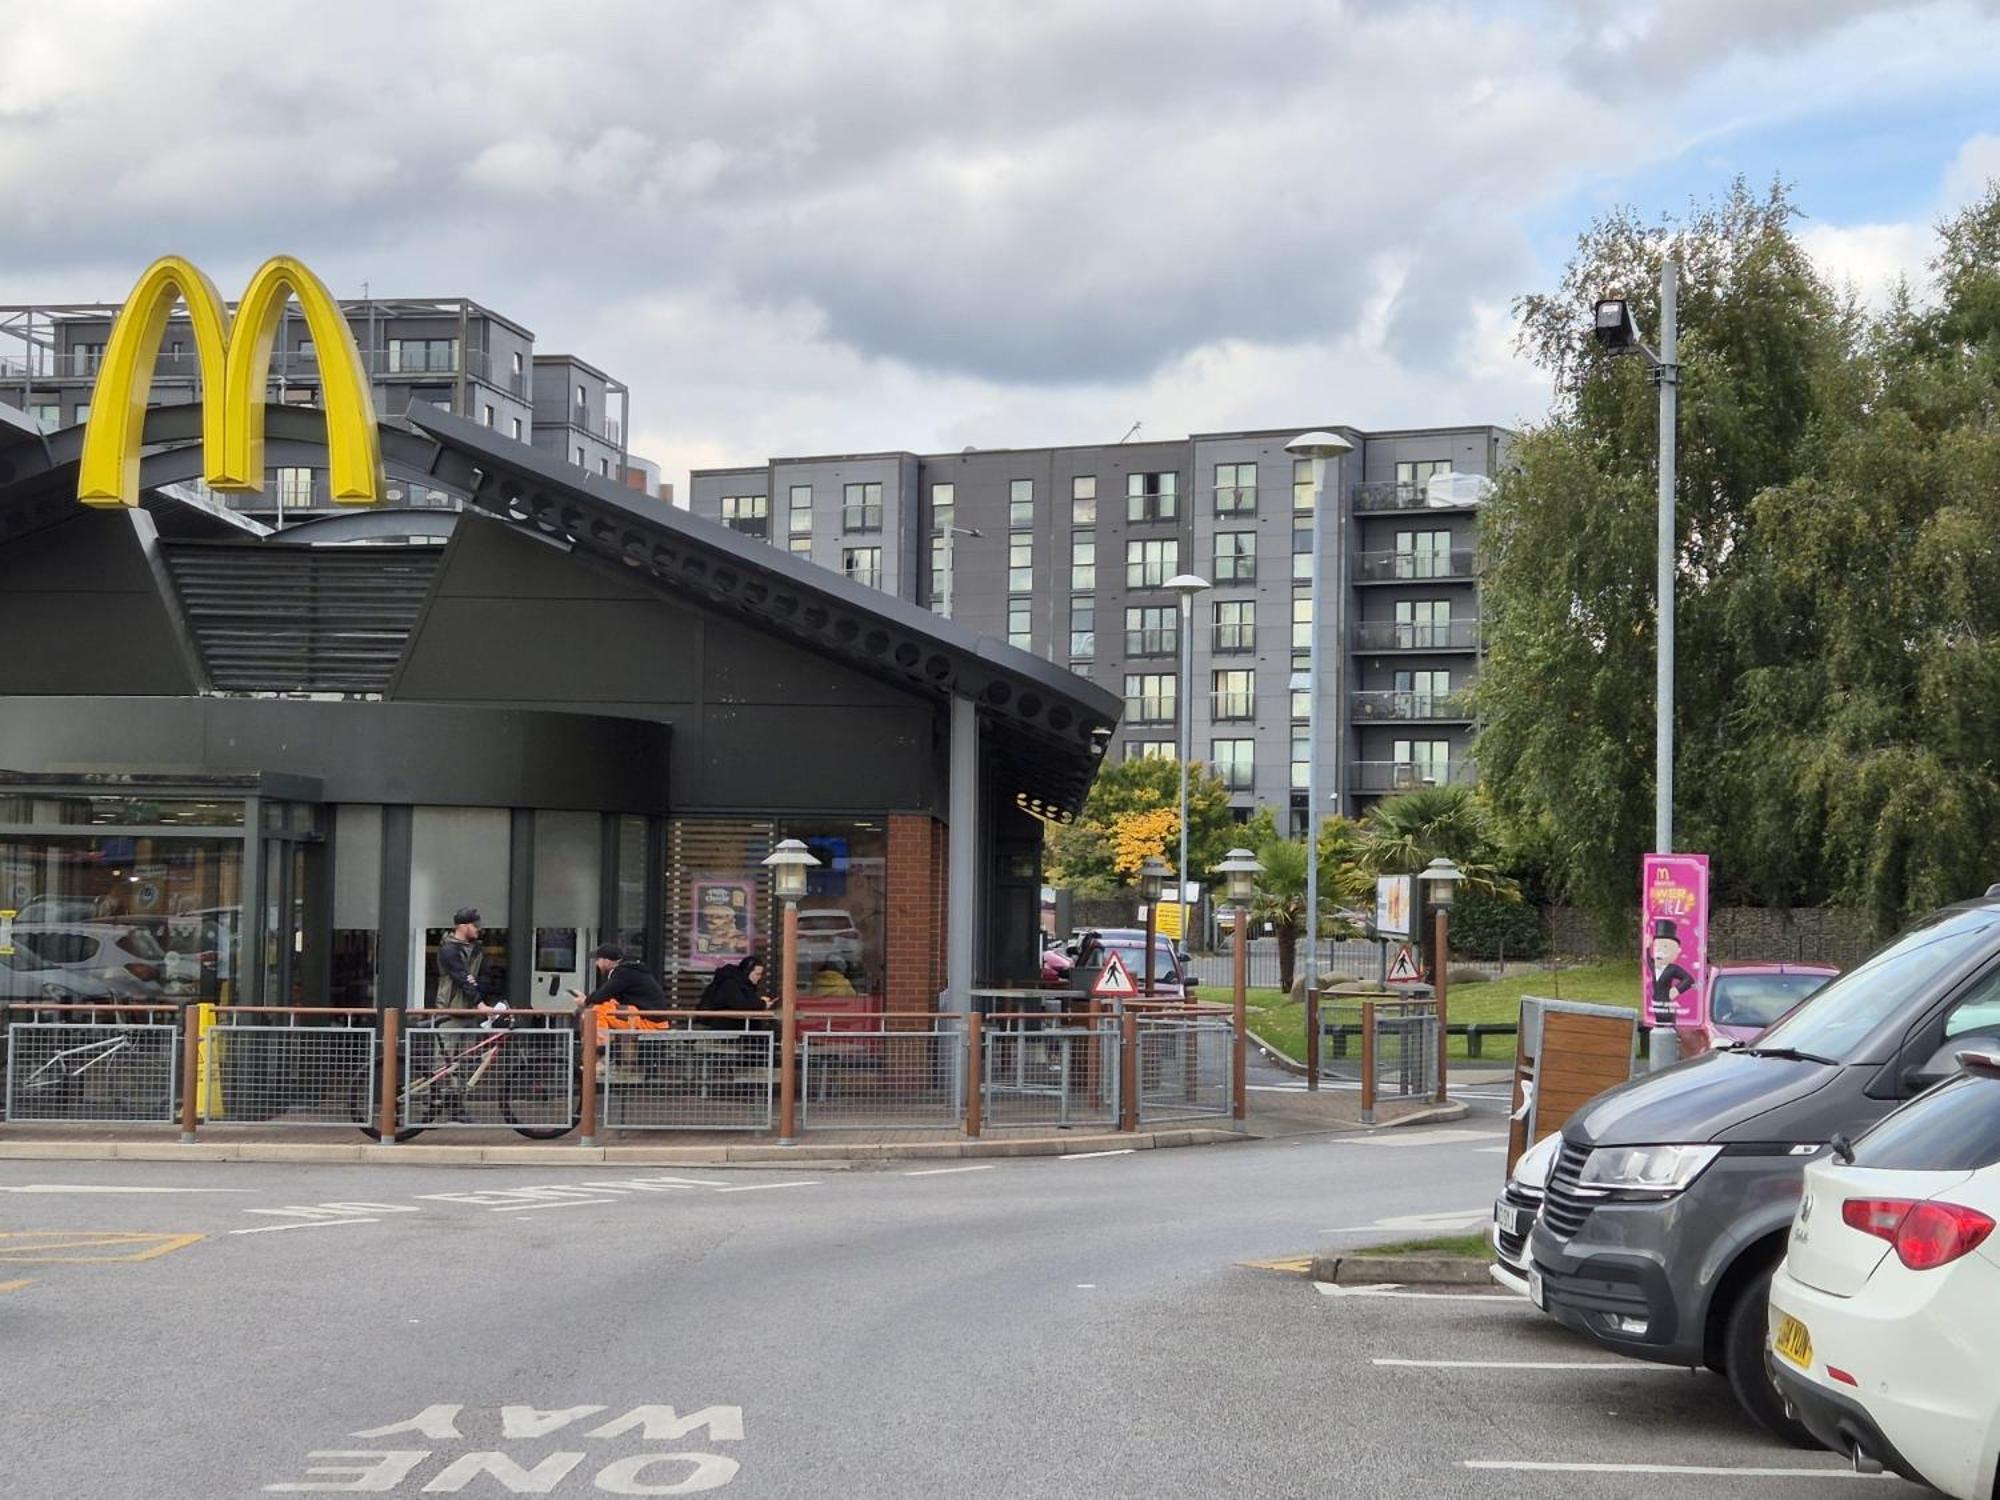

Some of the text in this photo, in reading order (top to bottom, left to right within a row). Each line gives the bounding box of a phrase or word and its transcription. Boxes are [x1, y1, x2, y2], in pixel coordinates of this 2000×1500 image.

[242, 1177, 731, 1219] NO ENTRY
[348, 1404, 745, 1440] WAY
[261, 1451, 741, 1495] ONE
